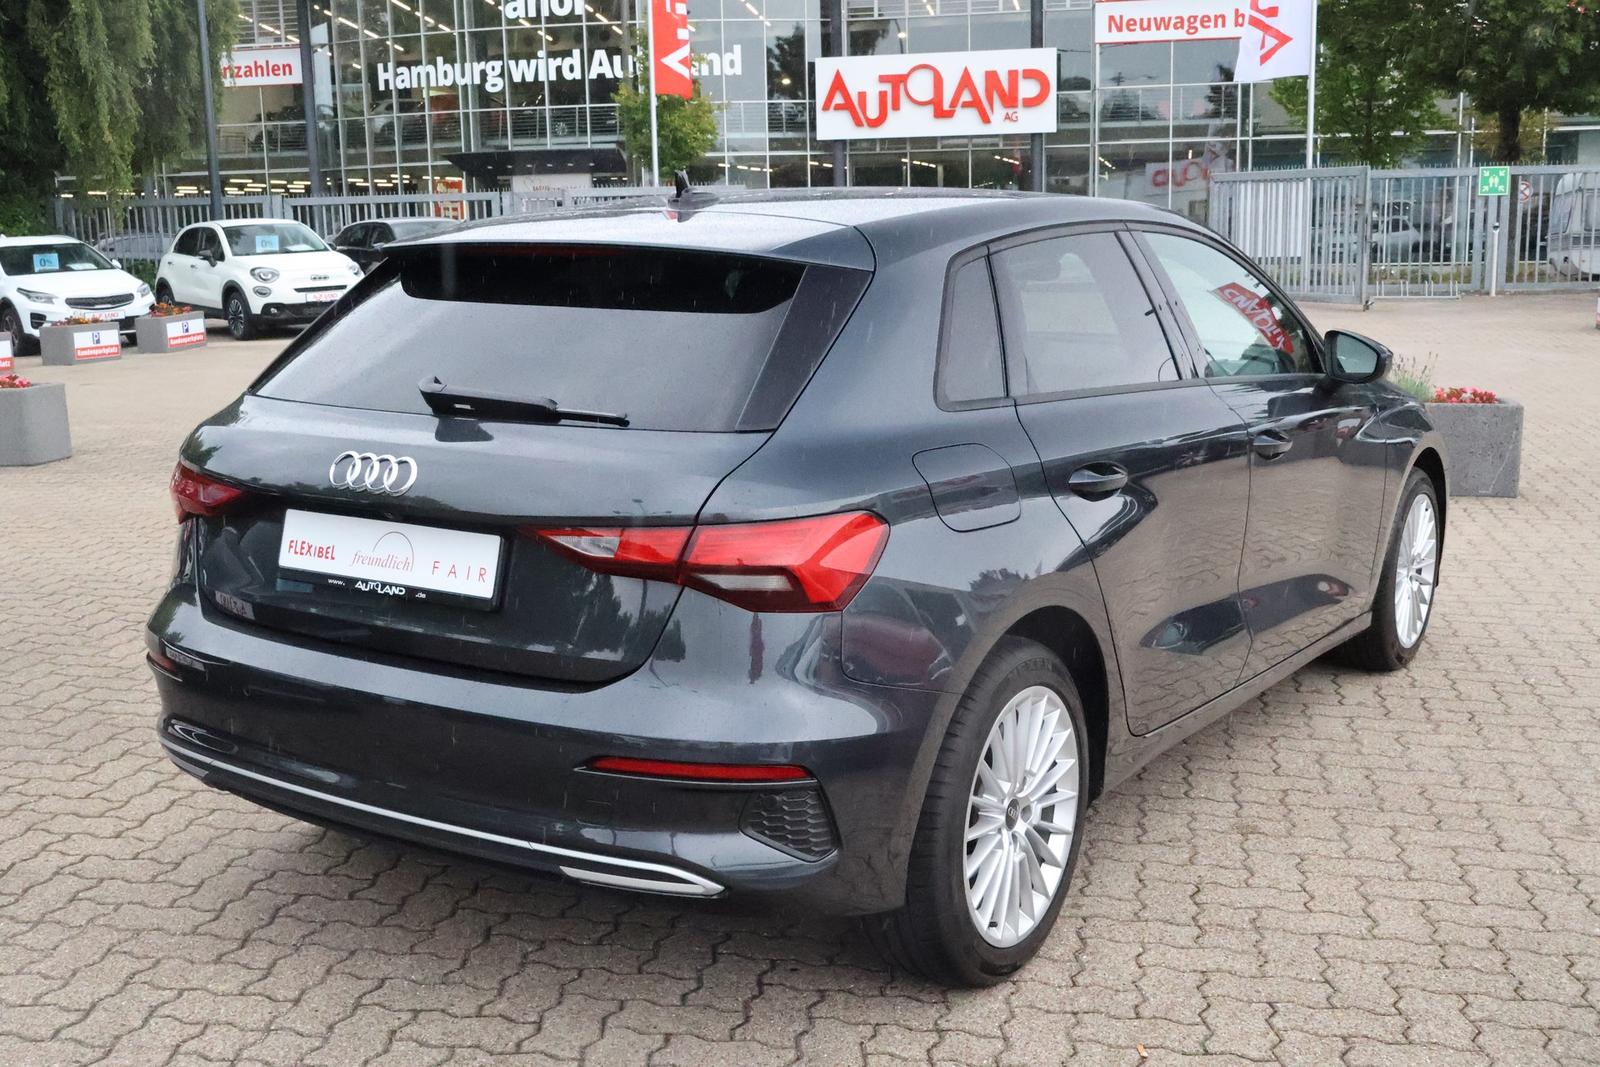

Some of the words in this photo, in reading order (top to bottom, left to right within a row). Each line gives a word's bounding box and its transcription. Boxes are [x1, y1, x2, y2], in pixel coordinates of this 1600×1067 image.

[1107, 11, 1232, 35] Neuwagen
[377, 56, 504, 92] Hamburg
[508, 50, 582, 83] wird
[821, 63, 1051, 128] AUTOLAND
[1003, 111, 1019, 122] AG
[288, 539, 336, 561] FLEXIBEL
[350, 550, 411, 572] freundlich
[355, 581, 406, 596] AUTOLAND
